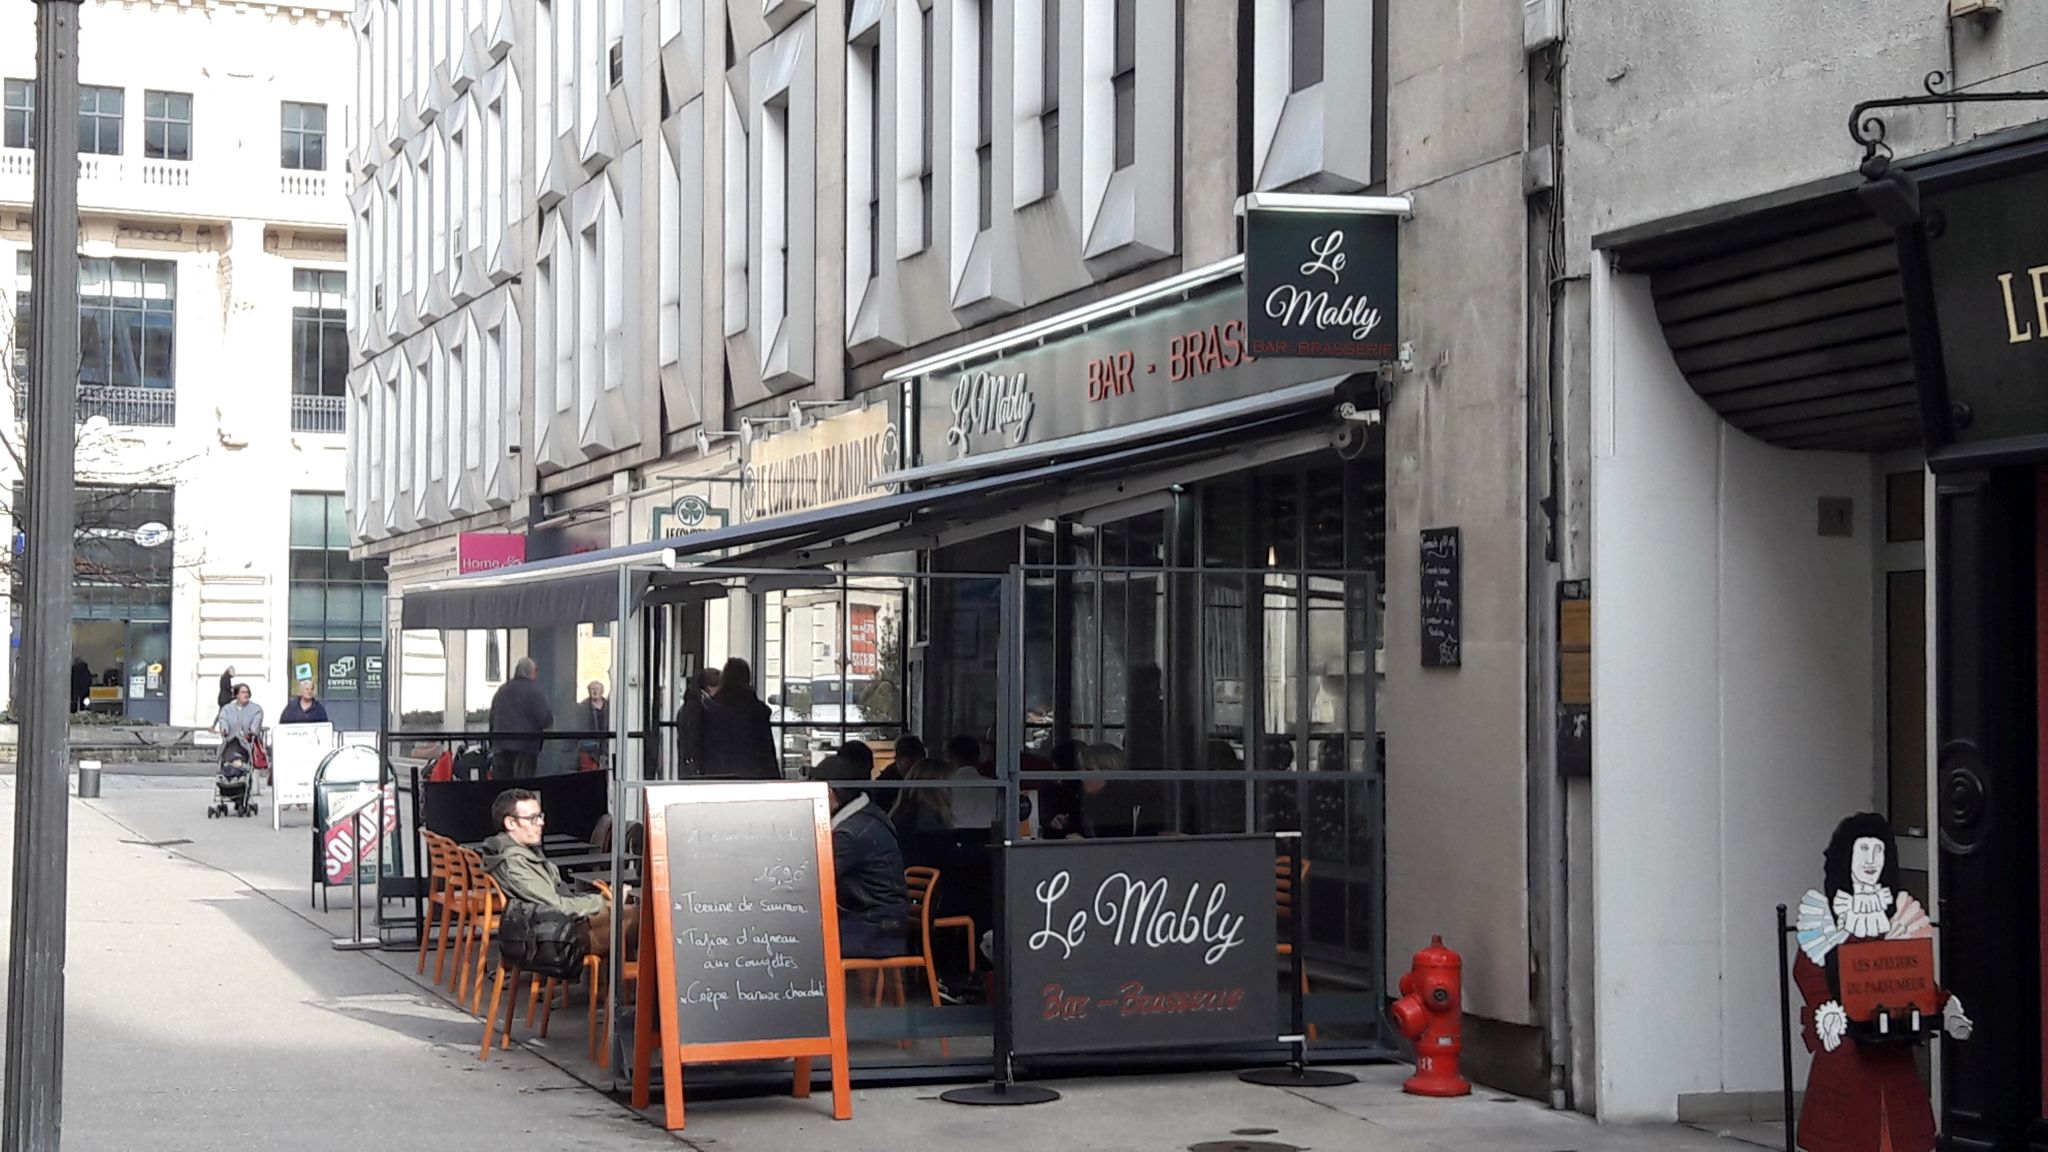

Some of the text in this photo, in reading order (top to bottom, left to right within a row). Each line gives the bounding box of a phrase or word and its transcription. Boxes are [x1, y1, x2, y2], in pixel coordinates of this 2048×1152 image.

[1300, 230, 1347, 285] Le
[1265, 284, 1382, 340] Mably
[1088, 350, 1134, 402] BAR
[970, 371, 1034, 444] Mably
[756, 432, 880, 518] LE COMPTOIR IRLANDAIS
[738, 895, 753, 912] de
[1028, 870, 1245, 965] Le Mably
